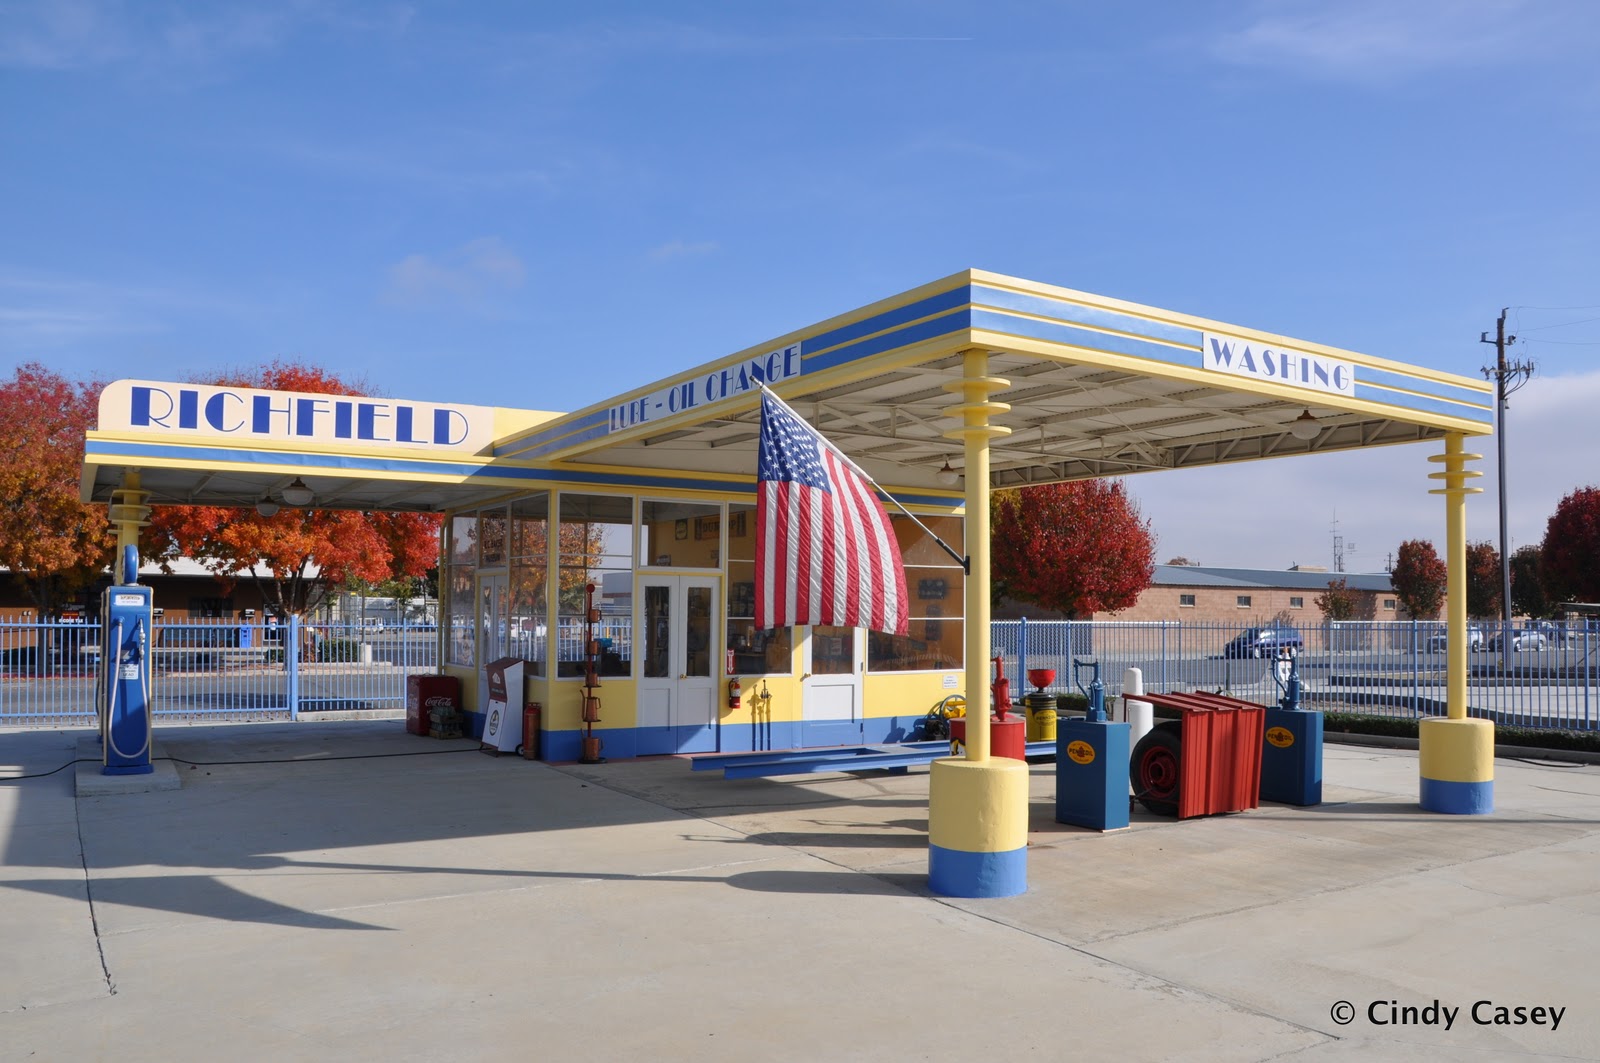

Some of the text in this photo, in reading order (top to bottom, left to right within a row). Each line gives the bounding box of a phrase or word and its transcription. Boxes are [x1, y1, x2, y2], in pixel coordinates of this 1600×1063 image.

[610, 397, 649, 432] LUBE
[668, 381, 698, 413] OIL
[705, 345, 798, 401] CHANGE
[1210, 338, 1349, 390] WASHING
[130, 386, 469, 446] RICHFIELD
[703, 520, 736, 532] DUNP
